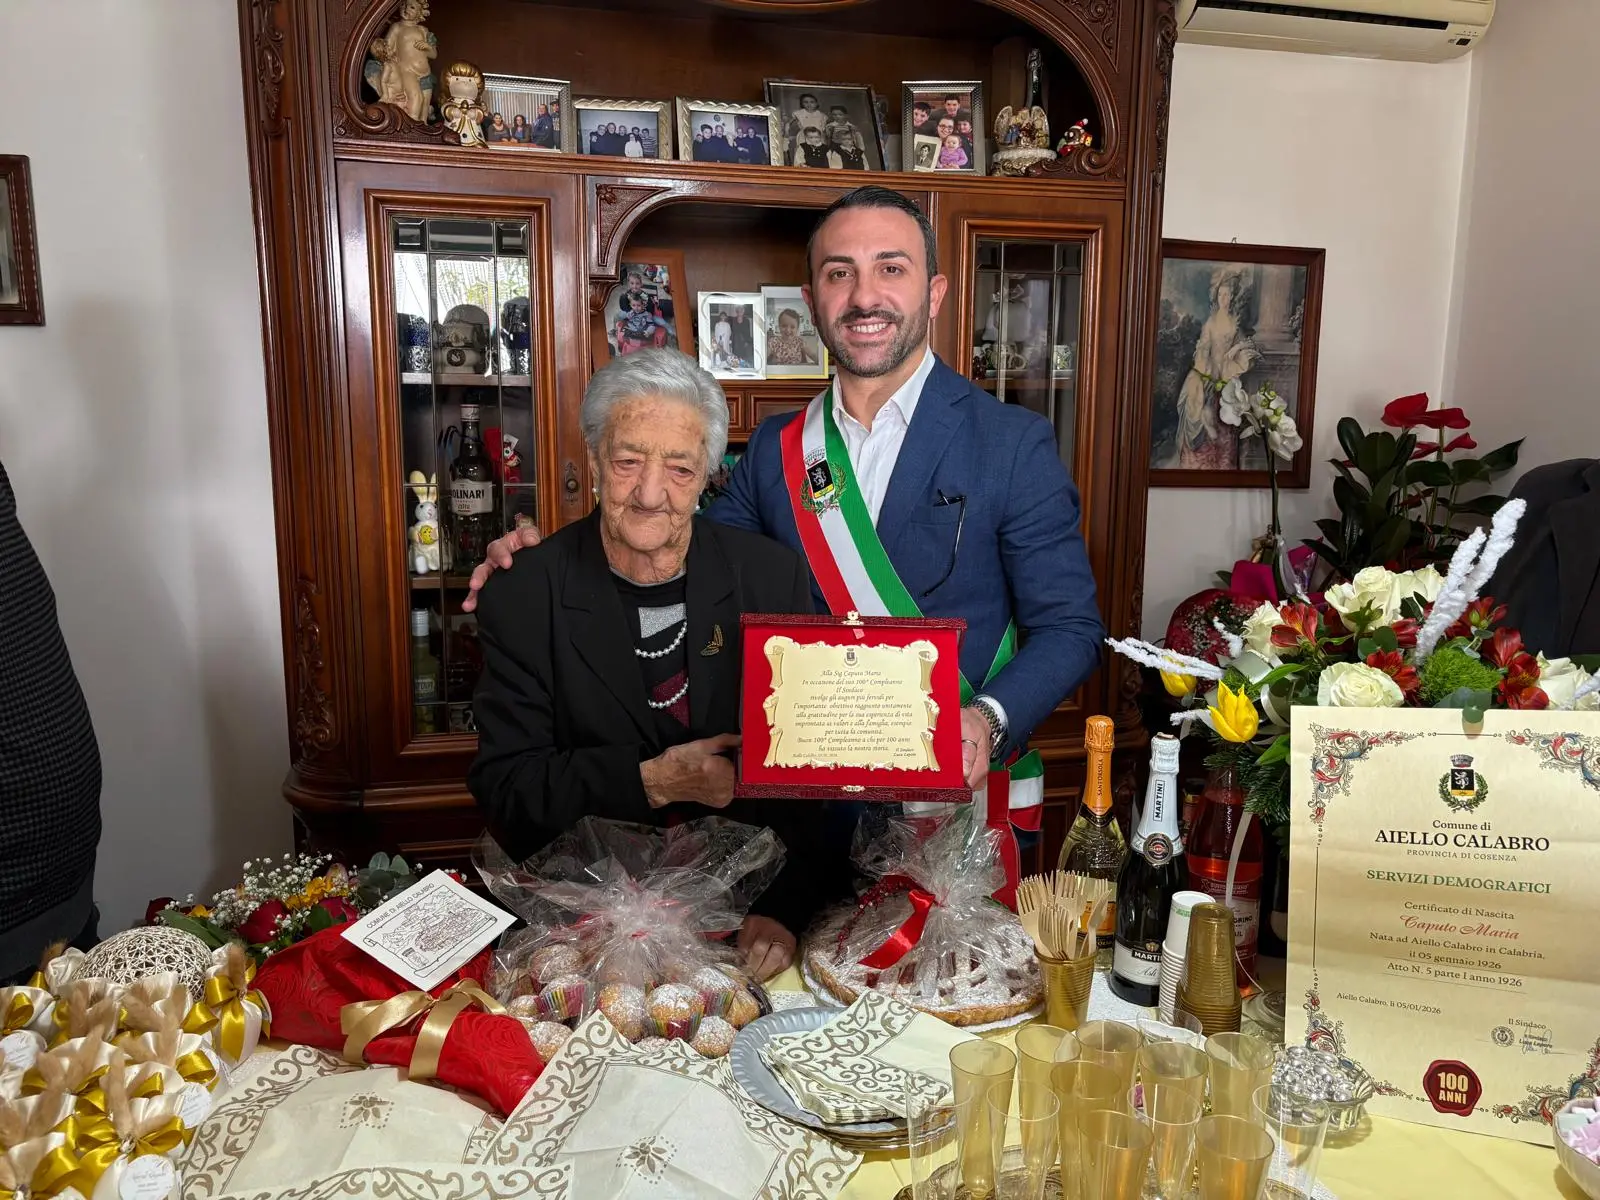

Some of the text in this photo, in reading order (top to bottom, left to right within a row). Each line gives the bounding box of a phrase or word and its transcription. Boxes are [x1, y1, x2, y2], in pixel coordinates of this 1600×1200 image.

[843, 670, 864, 678] Caputo
[870, 678, 904, 686] Compleanno
[828, 693, 837, 702] gli
[806, 711, 838, 720] gratitudine
[866, 712, 894, 720] esperienza
[854, 703, 881, 711] raggiunto
[828, 736, 862, 744] Compleanno
[876, 736, 886, 744] per
[1154, 783, 1164, 818] MARTINI
[1432, 819, 1491, 831] Comune di
[1375, 830, 1550, 852] AIELLO CALABRO
[1407, 850, 1458, 859] PROVINCIA
[1473, 852, 1518, 862] COSENZA
[1366, 869, 1552, 894] SERVIZI DEMOGRAFICI
[366, 912, 391, 929] COMUNE
[396, 896, 414, 910] AIELLO
[412, 882, 435, 899] CALABRO
[1404, 901, 1515, 920] Certificato di Nascita
[1400, 915, 1520, 940] Caputo Maria
[1370, 932, 1394, 942] Nata
[1411, 937, 1441, 948] Aiello
[1443, 940, 1483, 952] Calabro
[1485, 946, 1496, 954] in
[1134, 951, 1162, 962] MARTI
[1409, 950, 1502, 970] il 05 gennaio 1926
[1387, 962, 1409, 972] Atto
[1411, 964, 1424, 974] N.
[1426, 966, 1432, 974] 5
[1434, 969, 1460, 980] parte
[1469, 974, 1496, 984] anno
[1498, 976, 1522, 987] 1926
[1336, 992, 1358, 1001] Aiello
[1396, 1001, 1442, 1015] 05/01/2026
[1515, 1019, 1547, 1030] Sindaco
[1437, 1072, 1469, 1092] 100
[1438, 1090, 1467, 1105] ANNI
